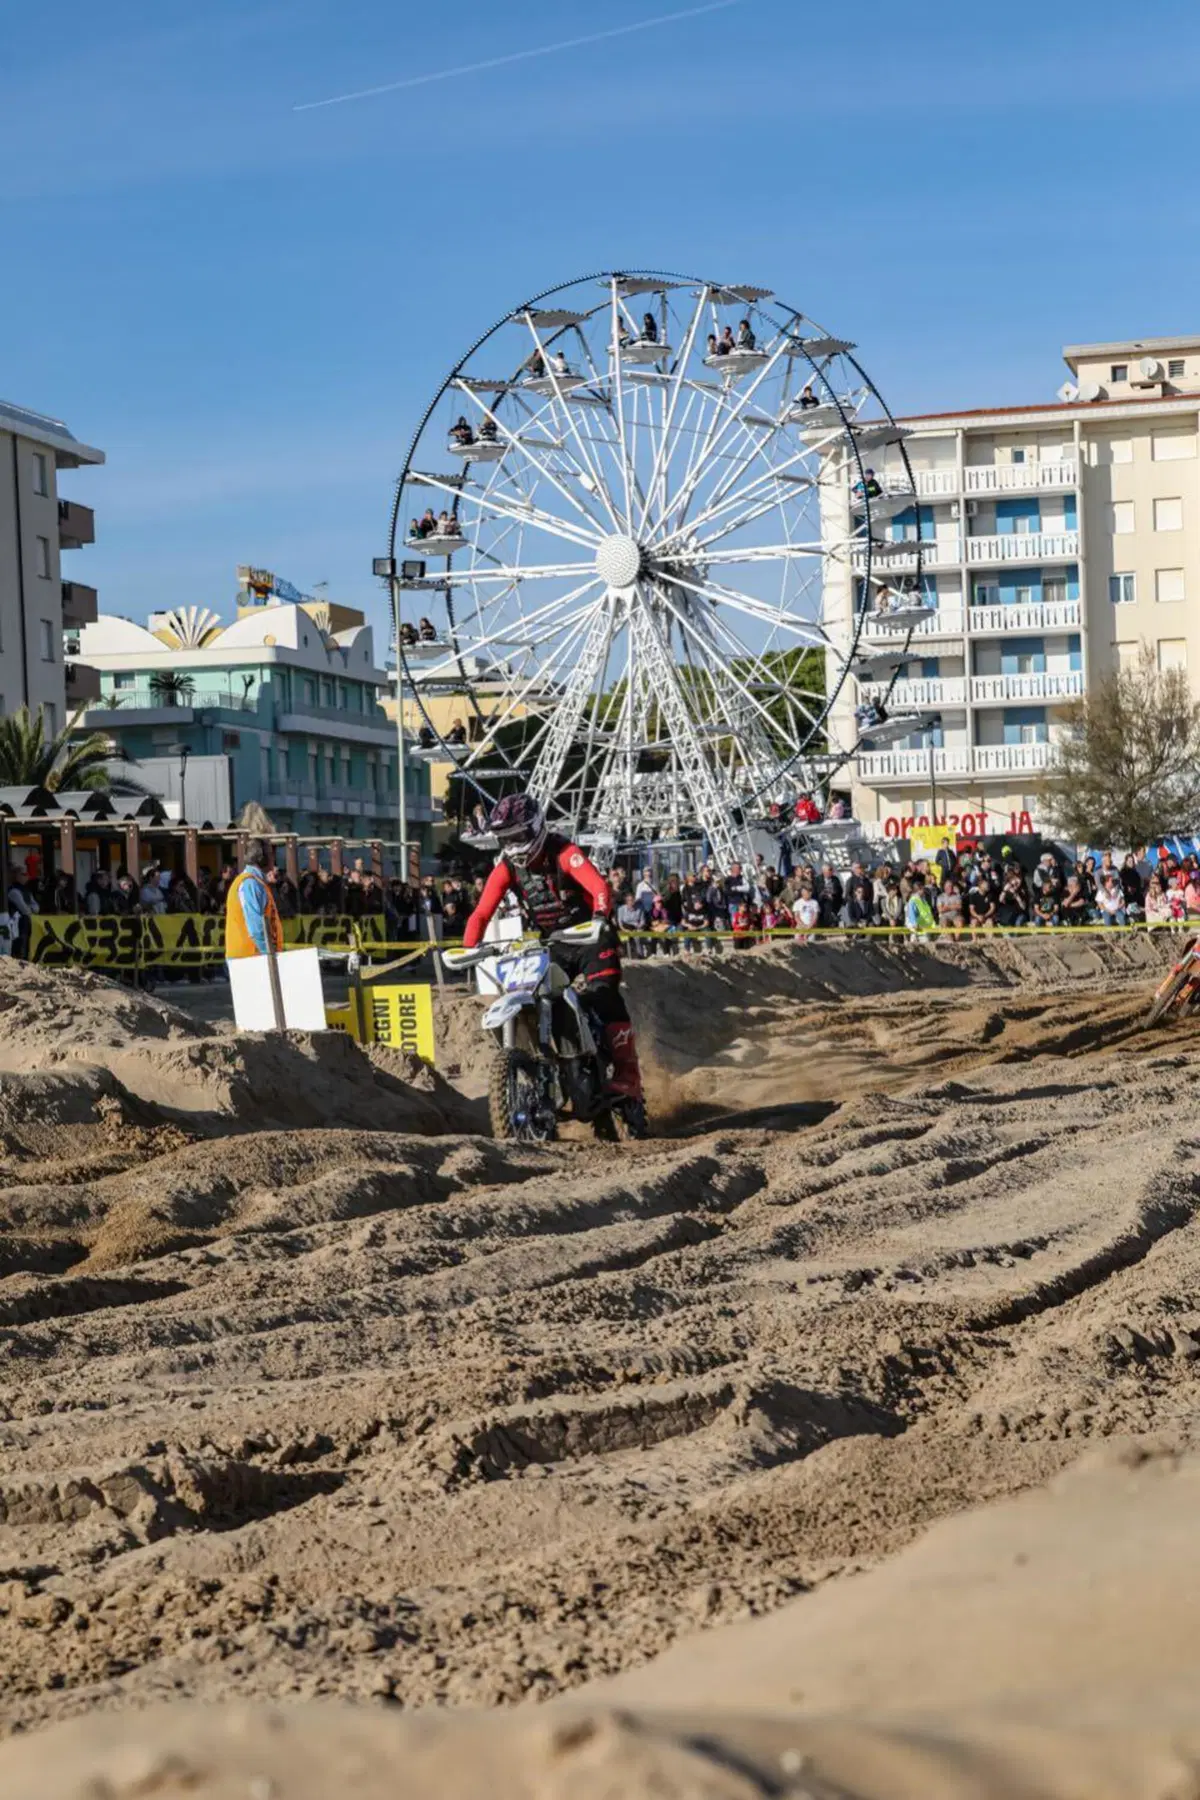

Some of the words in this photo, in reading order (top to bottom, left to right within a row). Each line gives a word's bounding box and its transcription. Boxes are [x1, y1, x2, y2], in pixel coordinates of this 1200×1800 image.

[499, 955, 541, 989] 742
[372, 998, 391, 1042] EGNI
[398, 993, 418, 1053] OTORE
